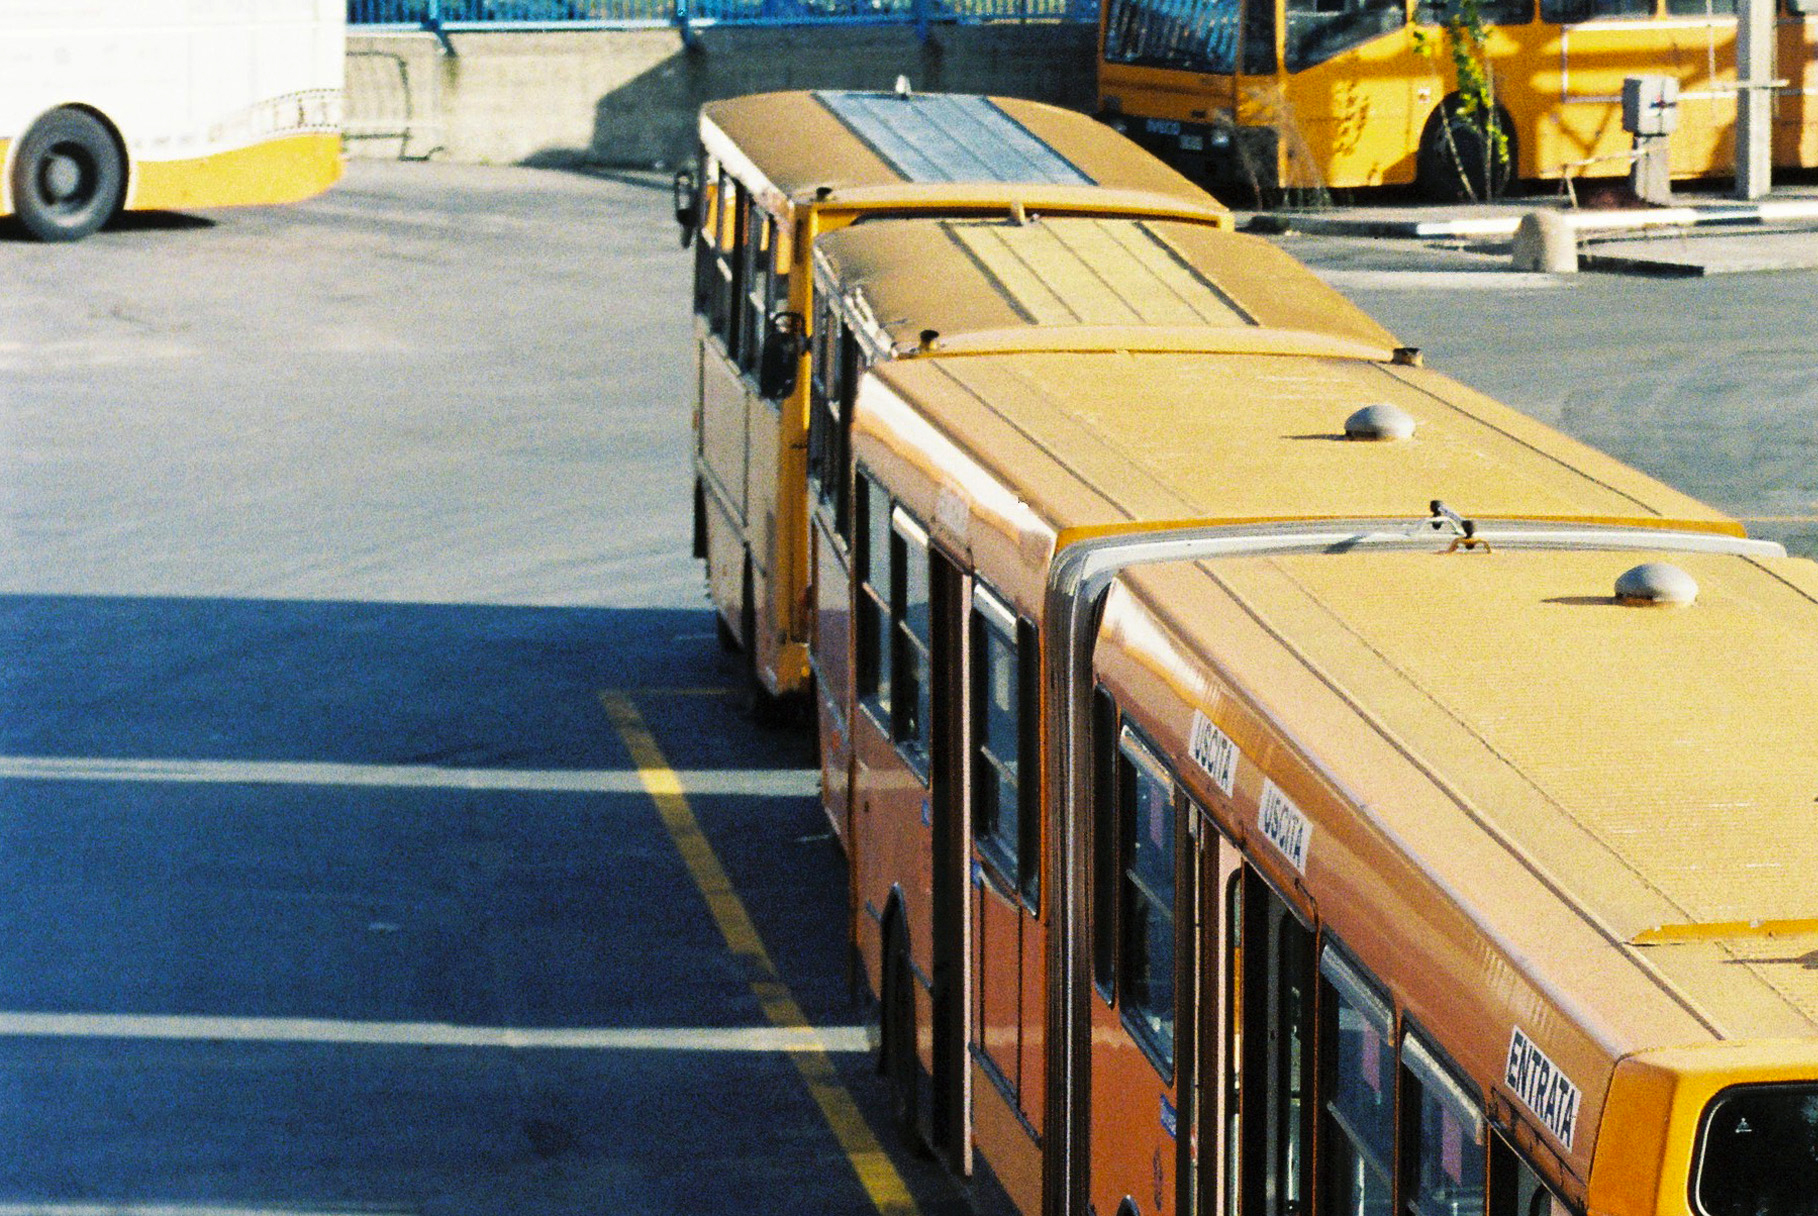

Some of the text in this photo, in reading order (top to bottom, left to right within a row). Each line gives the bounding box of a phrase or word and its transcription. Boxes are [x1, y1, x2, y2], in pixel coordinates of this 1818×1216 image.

[1194, 716, 1235, 794] USCITA
[1263, 789, 1306, 868] USCITA
[1506, 1030, 1576, 1148] ENTRATA
